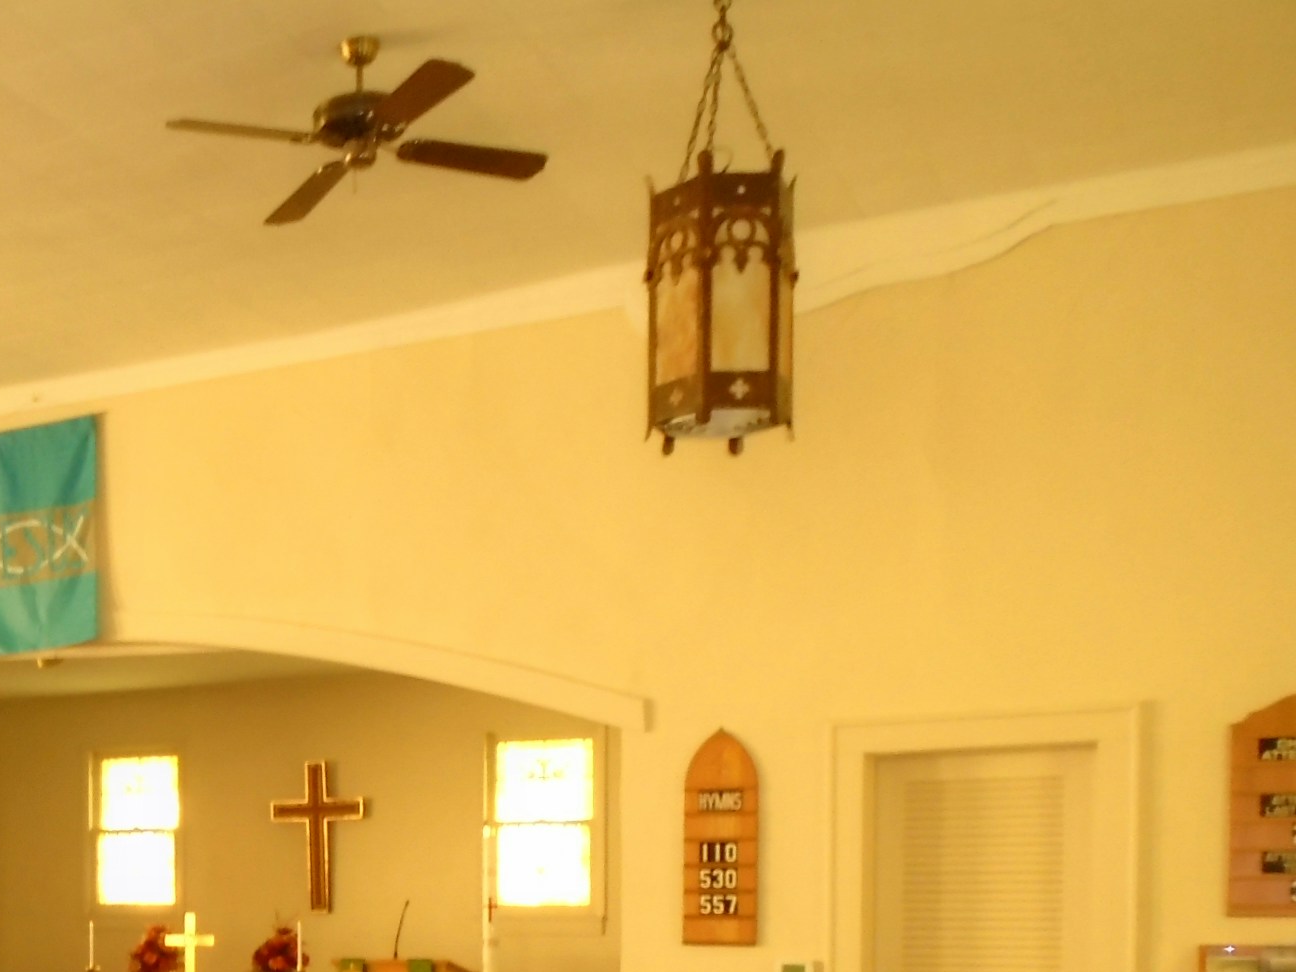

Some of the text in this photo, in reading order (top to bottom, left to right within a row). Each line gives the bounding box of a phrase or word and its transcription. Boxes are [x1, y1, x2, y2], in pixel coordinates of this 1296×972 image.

[698, 791, 742, 812] HYMNS
[702, 842, 738, 863] 110
[699, 868, 738, 889] 530
[699, 894, 738, 915] 557
